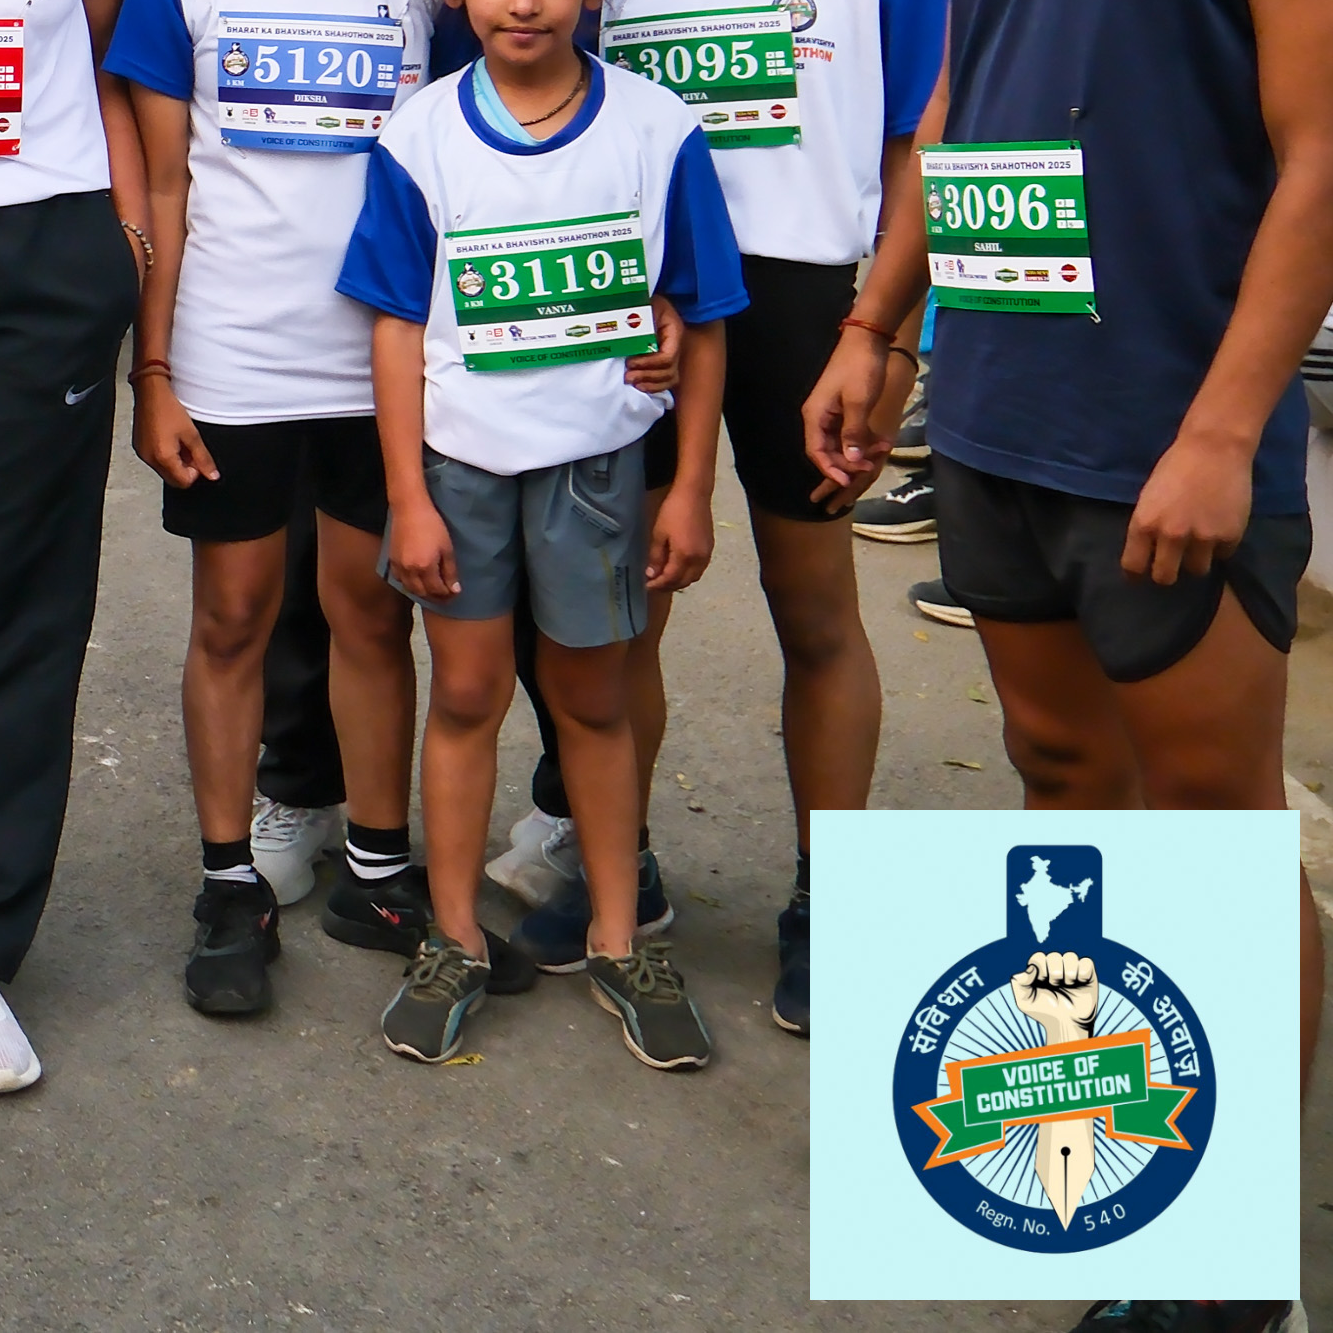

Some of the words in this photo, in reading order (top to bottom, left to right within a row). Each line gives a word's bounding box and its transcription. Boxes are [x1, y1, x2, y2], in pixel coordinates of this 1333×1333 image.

[275, 29, 322, 37] BHAVISHYA
[325, 31, 373, 39] SHAHOTHON
[612, 32, 639, 42] BHARAT
[653, 26, 698, 37] BHAVISHYA
[701, 22, 756, 32] SHAHOTHON
[254, 45, 372, 88] 5120
[639, 40, 758, 84] 3095
[294, 94, 327, 103] DIKSHA
[298, 139, 354, 148] CONSTITUTION
[991, 162, 1044, 170] SHAHOTHON
[1048, 161, 1071, 169] 2025
[945, 184, 1049, 230] 3096
[457, 243, 488, 253] BHARAT
[492, 242, 503, 250] KA
[507, 237, 556, 248] BHAVISHYA
[558, 231, 610, 243] SHAHOTHON
[612, 227, 632, 237] 2025
[975, 242, 1002, 252] SAHIL
[490, 250, 614, 301] 3119
[536, 304, 575, 316] VANYA
[510, 354, 536, 363] VOICE
[550, 346, 611, 360] CONSTITUTION
